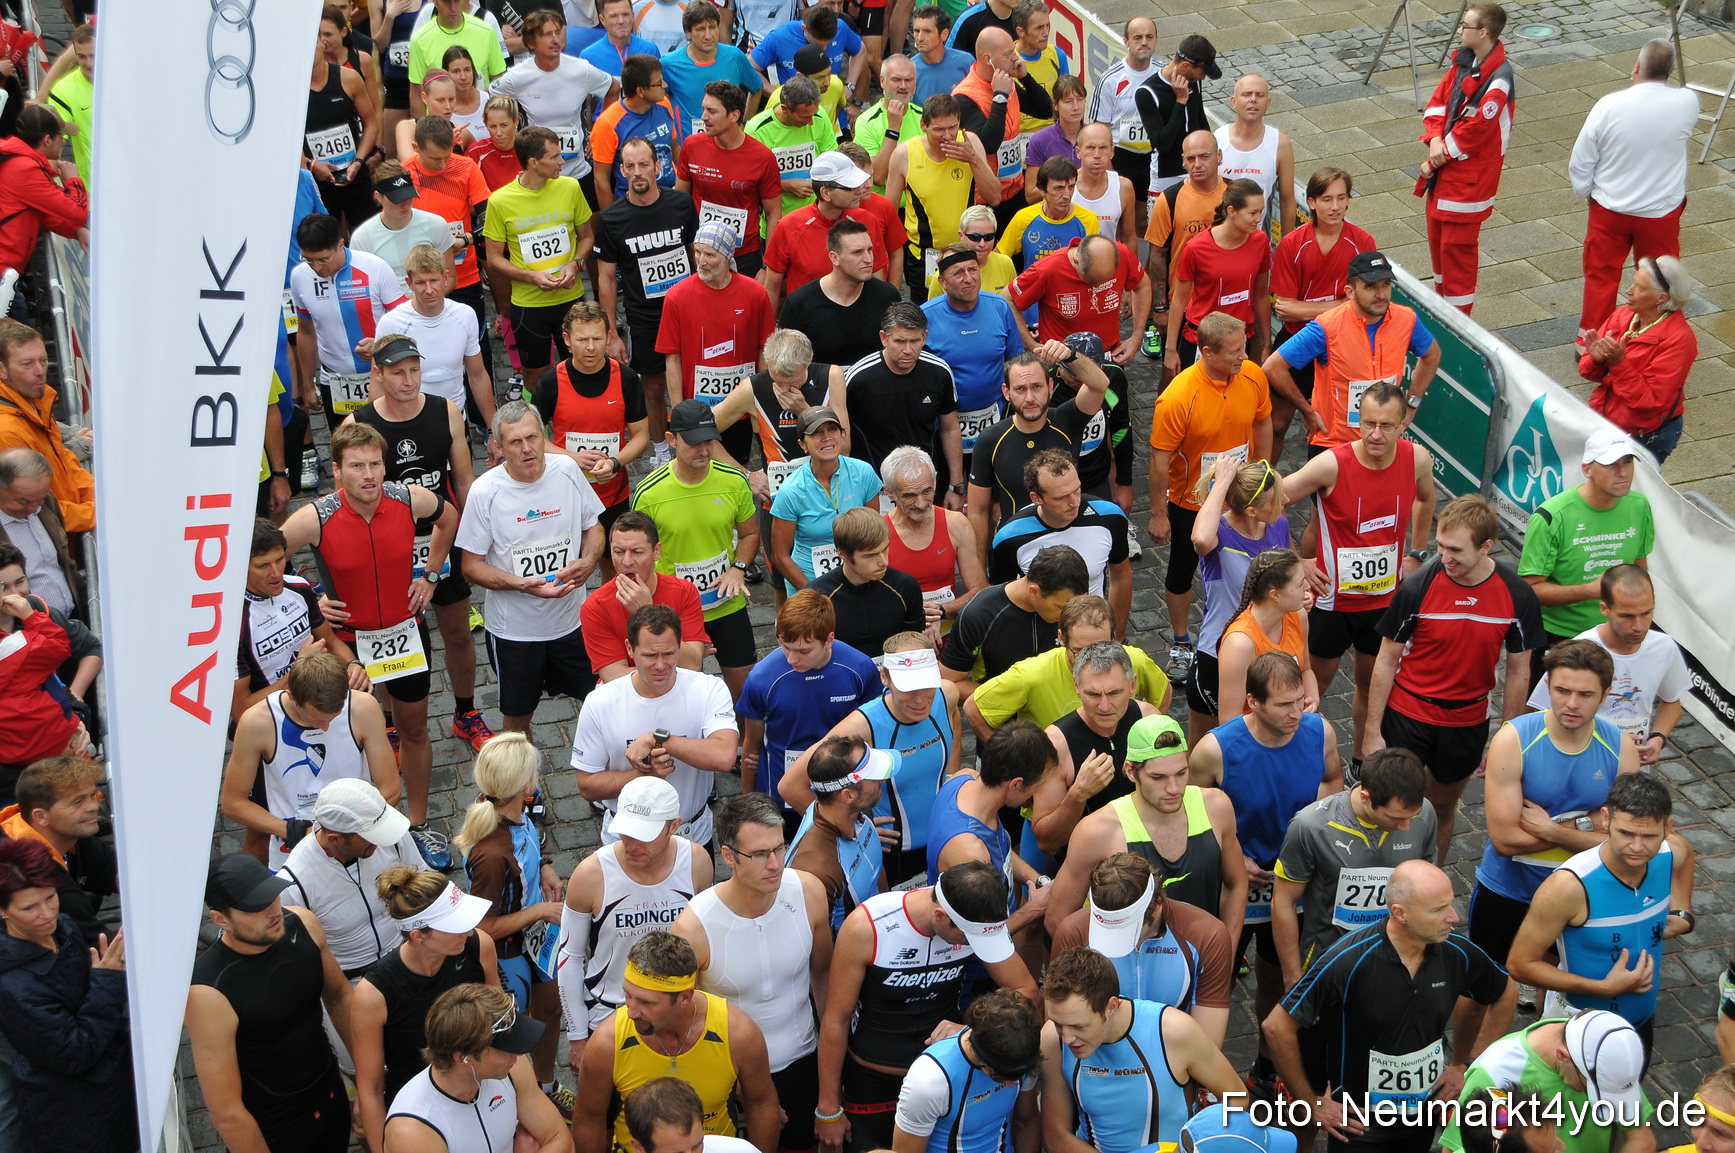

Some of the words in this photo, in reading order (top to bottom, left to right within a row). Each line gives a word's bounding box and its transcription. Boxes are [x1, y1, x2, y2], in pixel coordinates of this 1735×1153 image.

[309, 135, 323, 143] PARTL
[323, 130, 345, 139] Neumarkt
[314, 135, 351, 158] 2469
[778, 153, 813, 172] 3350
[717, 208, 739, 218] Neumarkt
[514, 212, 561, 230] CRAFT
[520, 235, 536, 243] PARTL
[536, 230, 560, 241] Neumarkt
[625, 228, 682, 254] THULE
[531, 238, 562, 259] 632
[640, 258, 656, 267] PARTL
[656, 253, 679, 265] Neumarkt
[646, 258, 686, 282] 2095
[190, 235, 247, 447] BKK
[971, 410, 992, 419] Neumarkt
[1369, 520, 1386, 528] DEHN
[1572, 532, 1626, 545] SCHMINKE
[513, 546, 534, 556] PARTL
[535, 541, 563, 553] Neumarkt
[813, 549, 831, 557] PARTL
[1361, 548, 1389, 558] Neumarkt
[520, 548, 569, 578] 2027
[676, 566, 697, 574] PARTL
[697, 558, 723, 570] Neumarkt
[1351, 557, 1388, 580] 309
[1371, 579, 1390, 589] Peter
[170, 493, 233, 725] Audi
[380, 626, 408, 639] Neumarkt
[371, 634, 410, 660] 232
[383, 661, 406, 673] Franz
[829, 694, 857, 702] SPORTCAMP
[1392, 842, 1413, 851] kicker
[1341, 874, 1367, 882] PARTL
[634, 901, 669, 911] TEAM
[882, 964, 964, 988] Energizer
[1371, 1057, 1398, 1067] PARTL
[1400, 1052, 1433, 1067] Neumarkt
[1377, 1059, 1438, 1091] 2618
